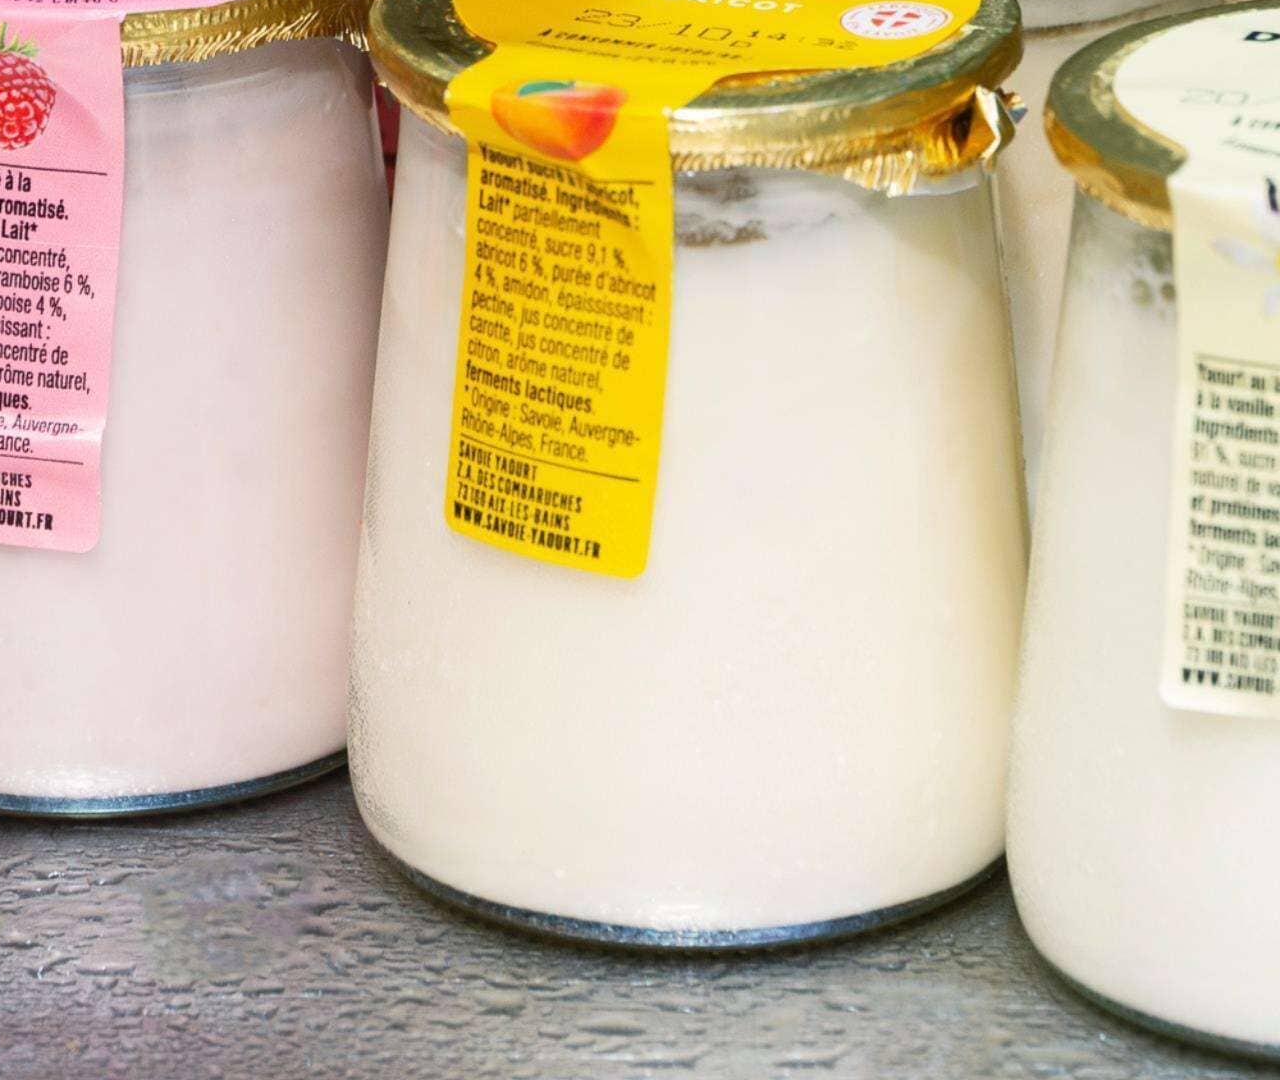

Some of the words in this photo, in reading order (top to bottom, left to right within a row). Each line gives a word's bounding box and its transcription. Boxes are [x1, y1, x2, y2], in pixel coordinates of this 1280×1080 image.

[5, 170, 13, 191] à
[18, 172, 31, 192] la
[480, 168, 551, 203] aromatisé.
[556, 187, 632, 228] Ingrédients
[513, 201, 600, 239] partiellement
[477, 217, 540, 253] concentré,
[545, 237, 582, 260] sucre
[587, 243, 606, 267] 9,1
[64, 275, 73, 294] 6
[77, 275, 95, 298] %,
[476, 239, 517, 265] abricot
[552, 264, 592, 287] purée
[596, 271, 656, 301] d'abricot
[36, 295, 45, 315] 4
[49, 298, 67, 320] %,
[471, 290, 518, 321] pectine,
[520, 306, 539, 326] jus
[543, 311, 612, 341] concentré
[617, 326, 634, 346] de
[503, 274, 552, 306] amidon,
[557, 290, 644, 324] épaississant
[51, 345, 68, 366] de
[469, 315, 513, 346] carotte,
[516, 330, 536, 350] jus
[539, 335, 609, 362] concentré
[613, 351, 630, 370] de
[37, 370, 91, 395] naturel,
[466, 359, 521, 396] ferments
[467, 338, 502, 367] citron,
[507, 351, 547, 377] arôme
[551, 363, 603, 394] naturel,
[12, 413, 85, 436] Auvergne-
[462, 407, 536, 452] Rhône-Alpes,
[540, 435, 588, 463] France.
[471, 385, 510, 417] Origine
[520, 402, 565, 434] Savoie,
[570, 416, 640, 447] Auvergne-
[459, 440, 491, 466] SAVOIE
[495, 454, 538, 482] YAOURT
[457, 481, 468, 501] 73
[477, 469, 495, 490] DES
[497, 475, 582, 513] COMBARUCHES
